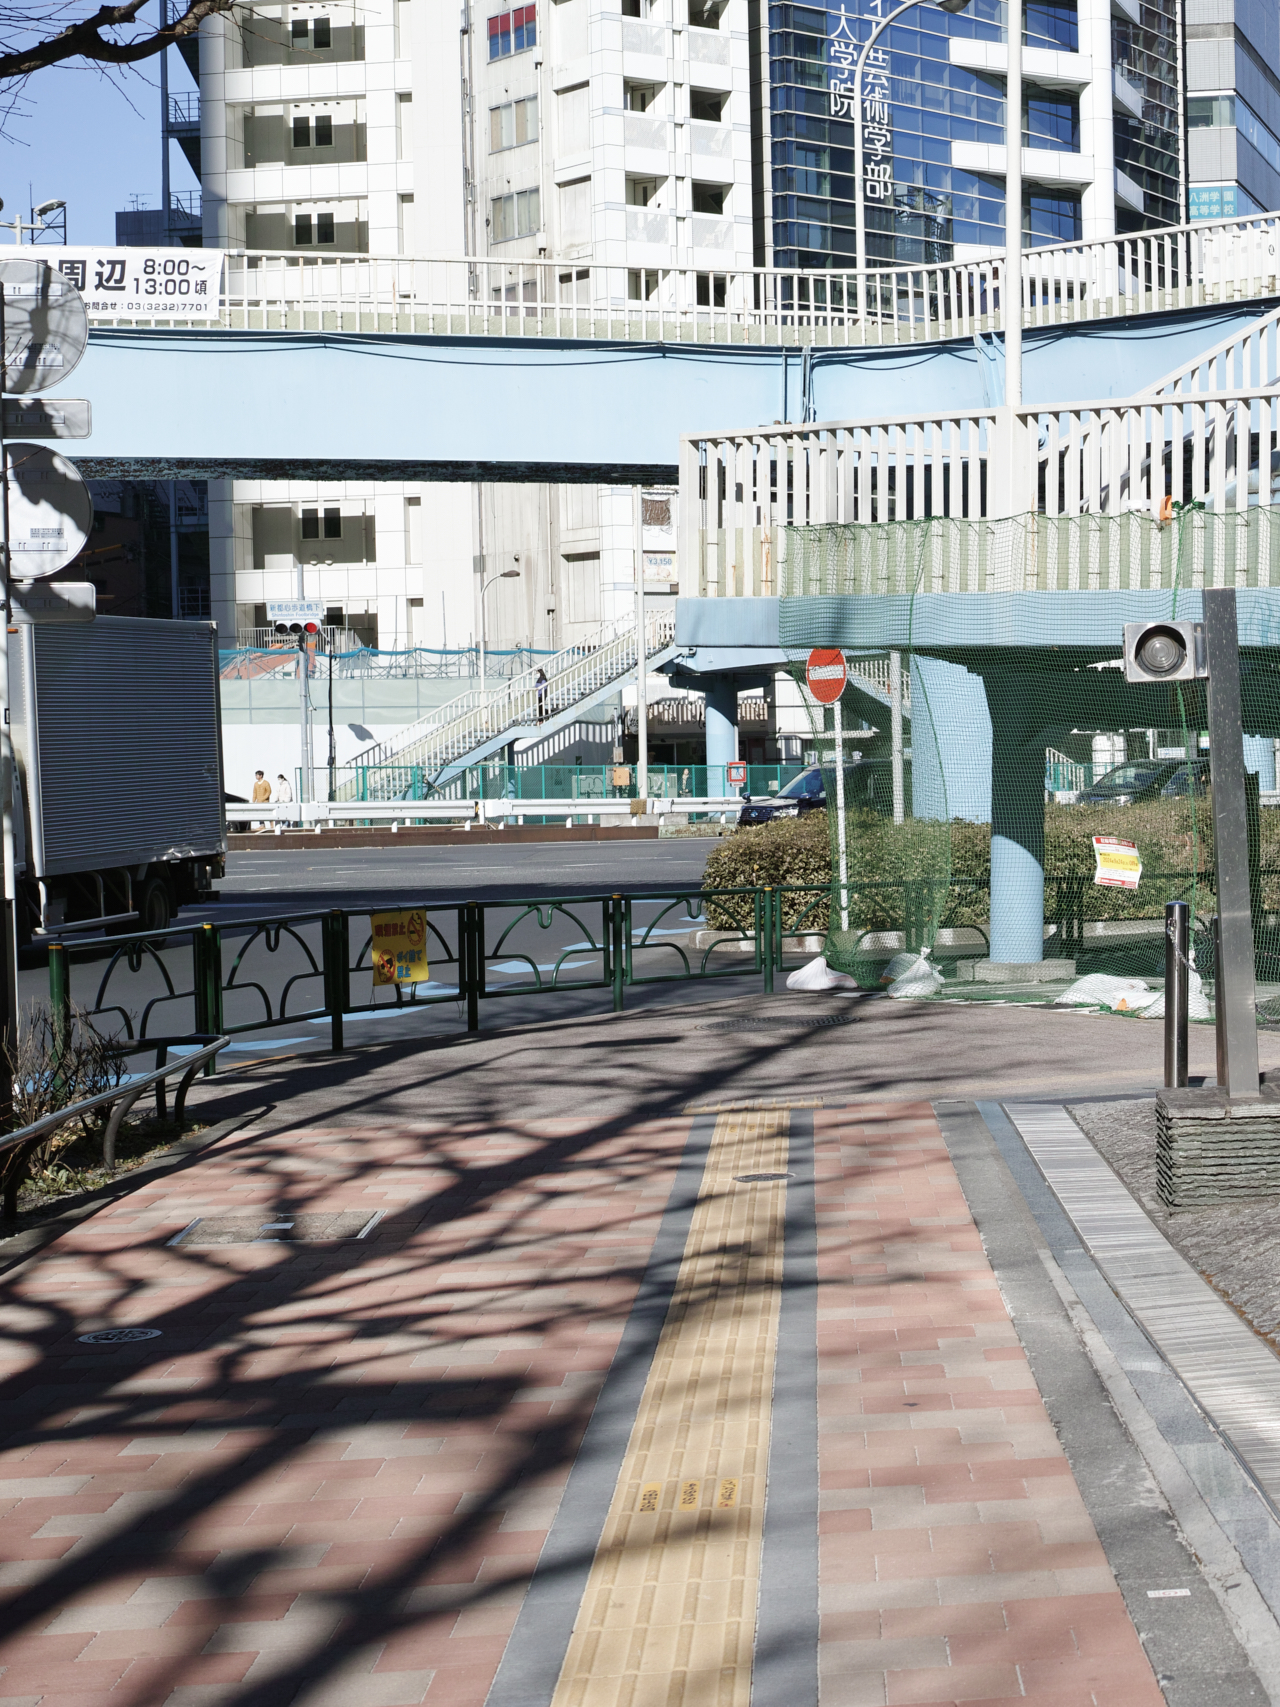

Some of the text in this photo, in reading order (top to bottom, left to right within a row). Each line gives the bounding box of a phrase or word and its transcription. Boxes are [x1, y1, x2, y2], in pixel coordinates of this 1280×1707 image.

[830, 3, 858, 120] 大学院
[1189, 190, 1235, 203] 八洲学園
[1189, 204, 1235, 216] 高等学校
[37, 259, 127, 292] 周辺
[397, 965, 411, 979] 禁止
